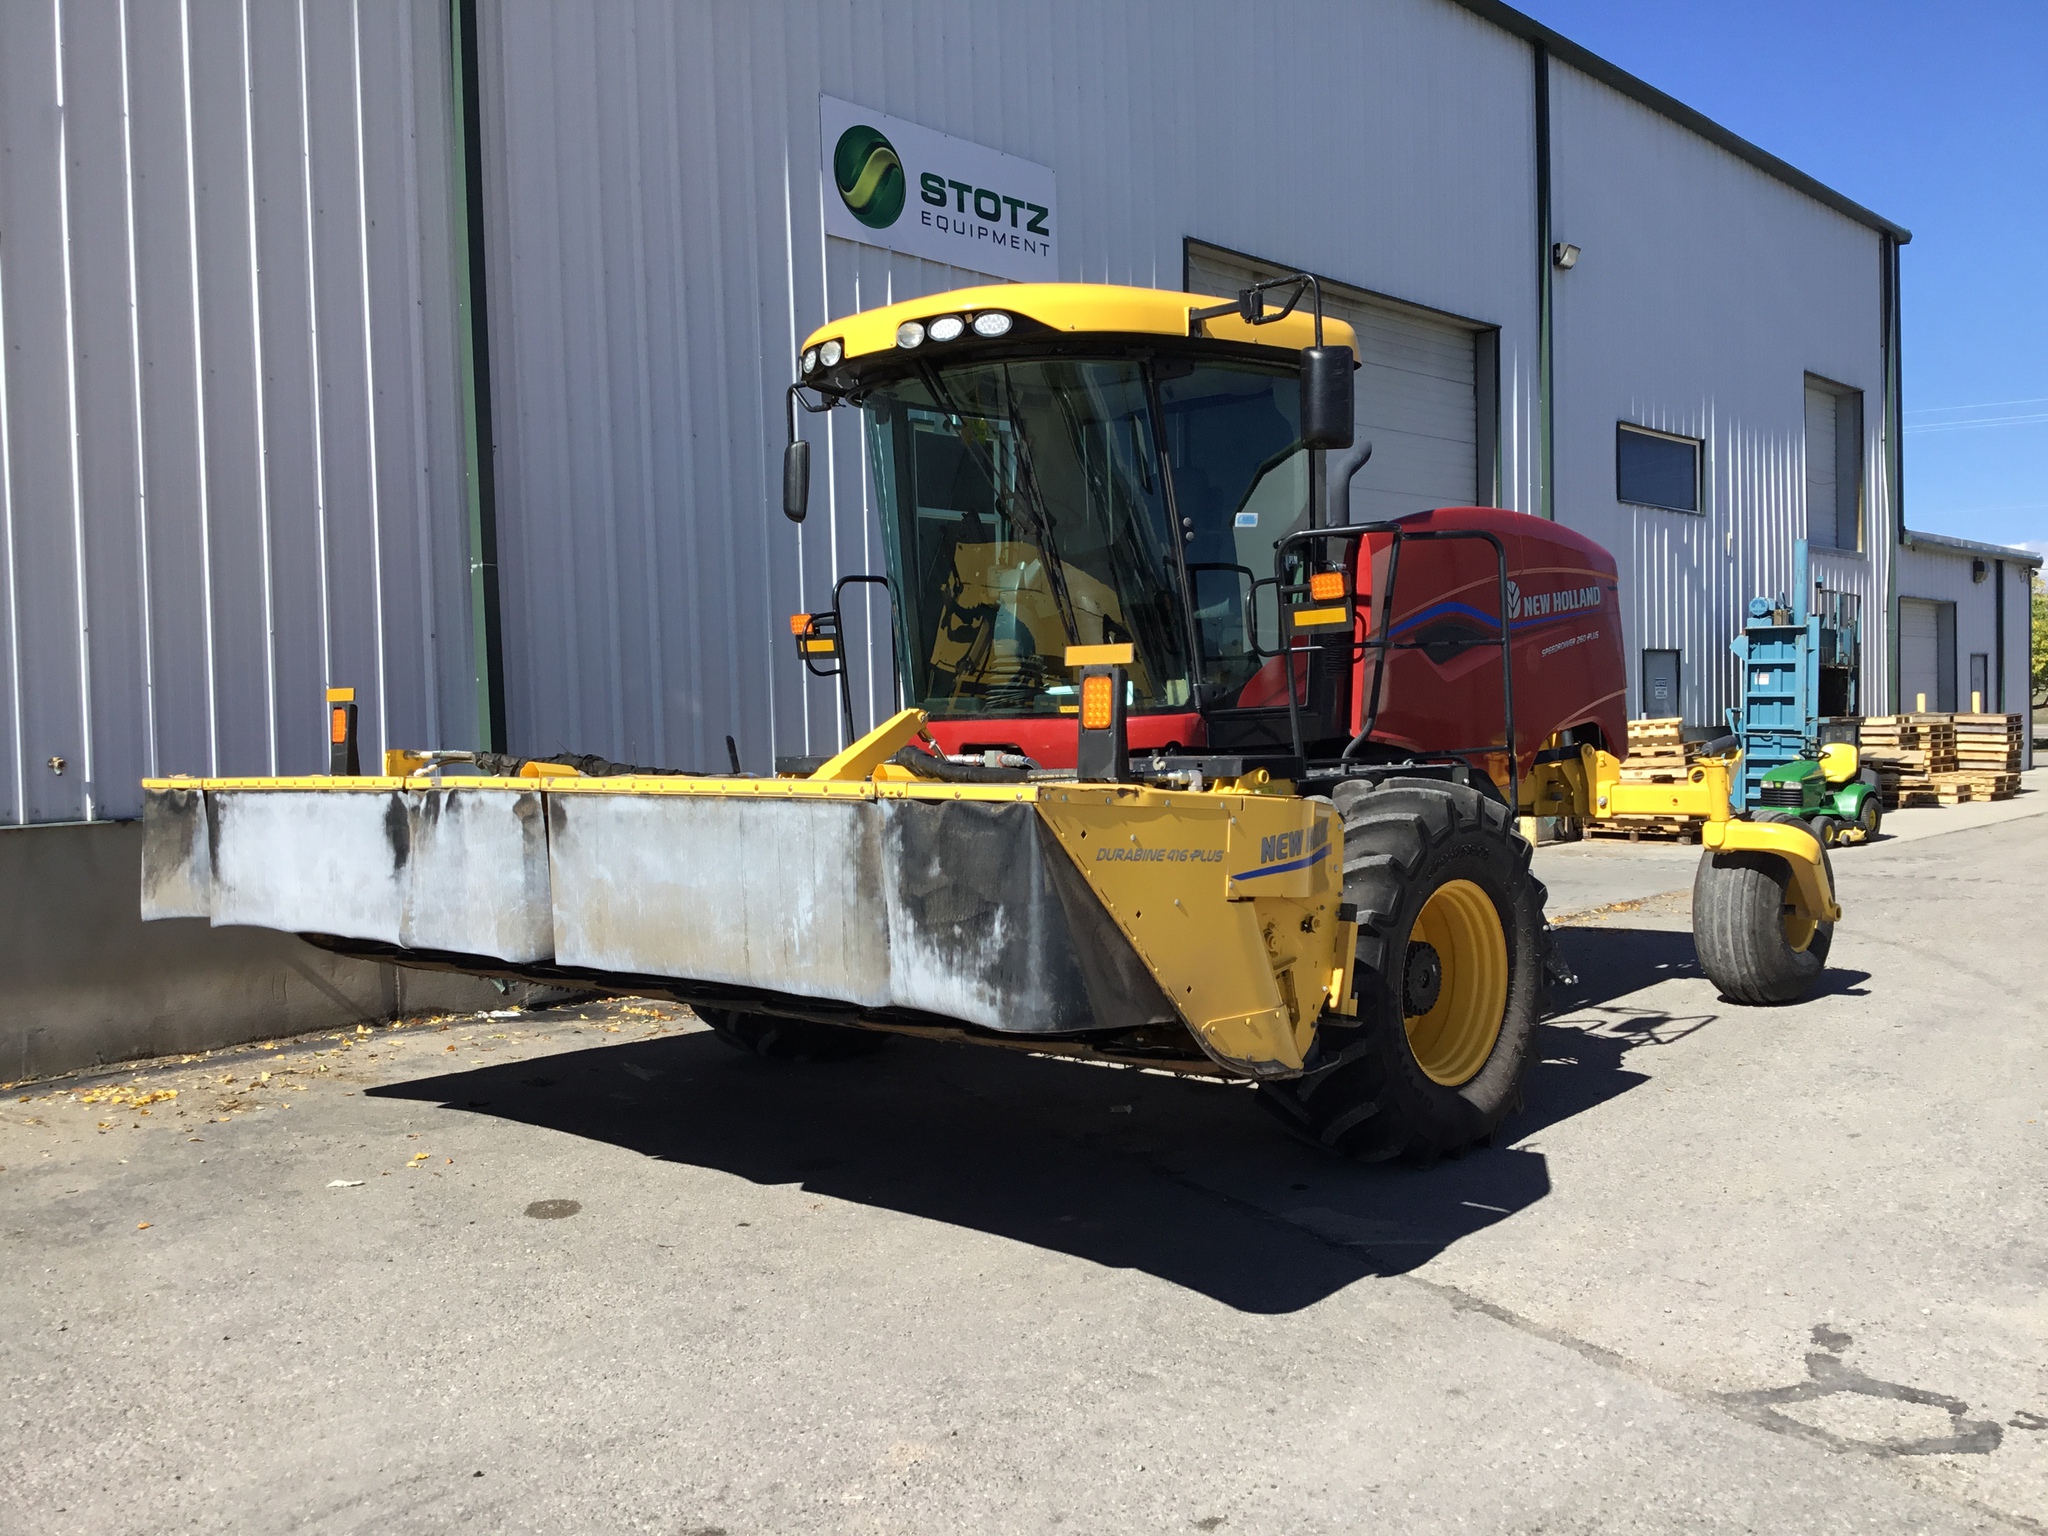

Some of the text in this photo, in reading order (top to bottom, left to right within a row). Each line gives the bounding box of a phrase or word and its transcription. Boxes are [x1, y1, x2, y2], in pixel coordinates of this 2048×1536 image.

[920, 172, 1049, 237] STOTZ
[921, 210, 1050, 257] EQUIPMENT
[1524, 586, 1600, 617] NEW HOLLAND
[1587, 631, 1599, 641] PLUS
[1095, 848, 1224, 862] DURABINE 416 PLUS
[1261, 829, 1304, 864] NEW
